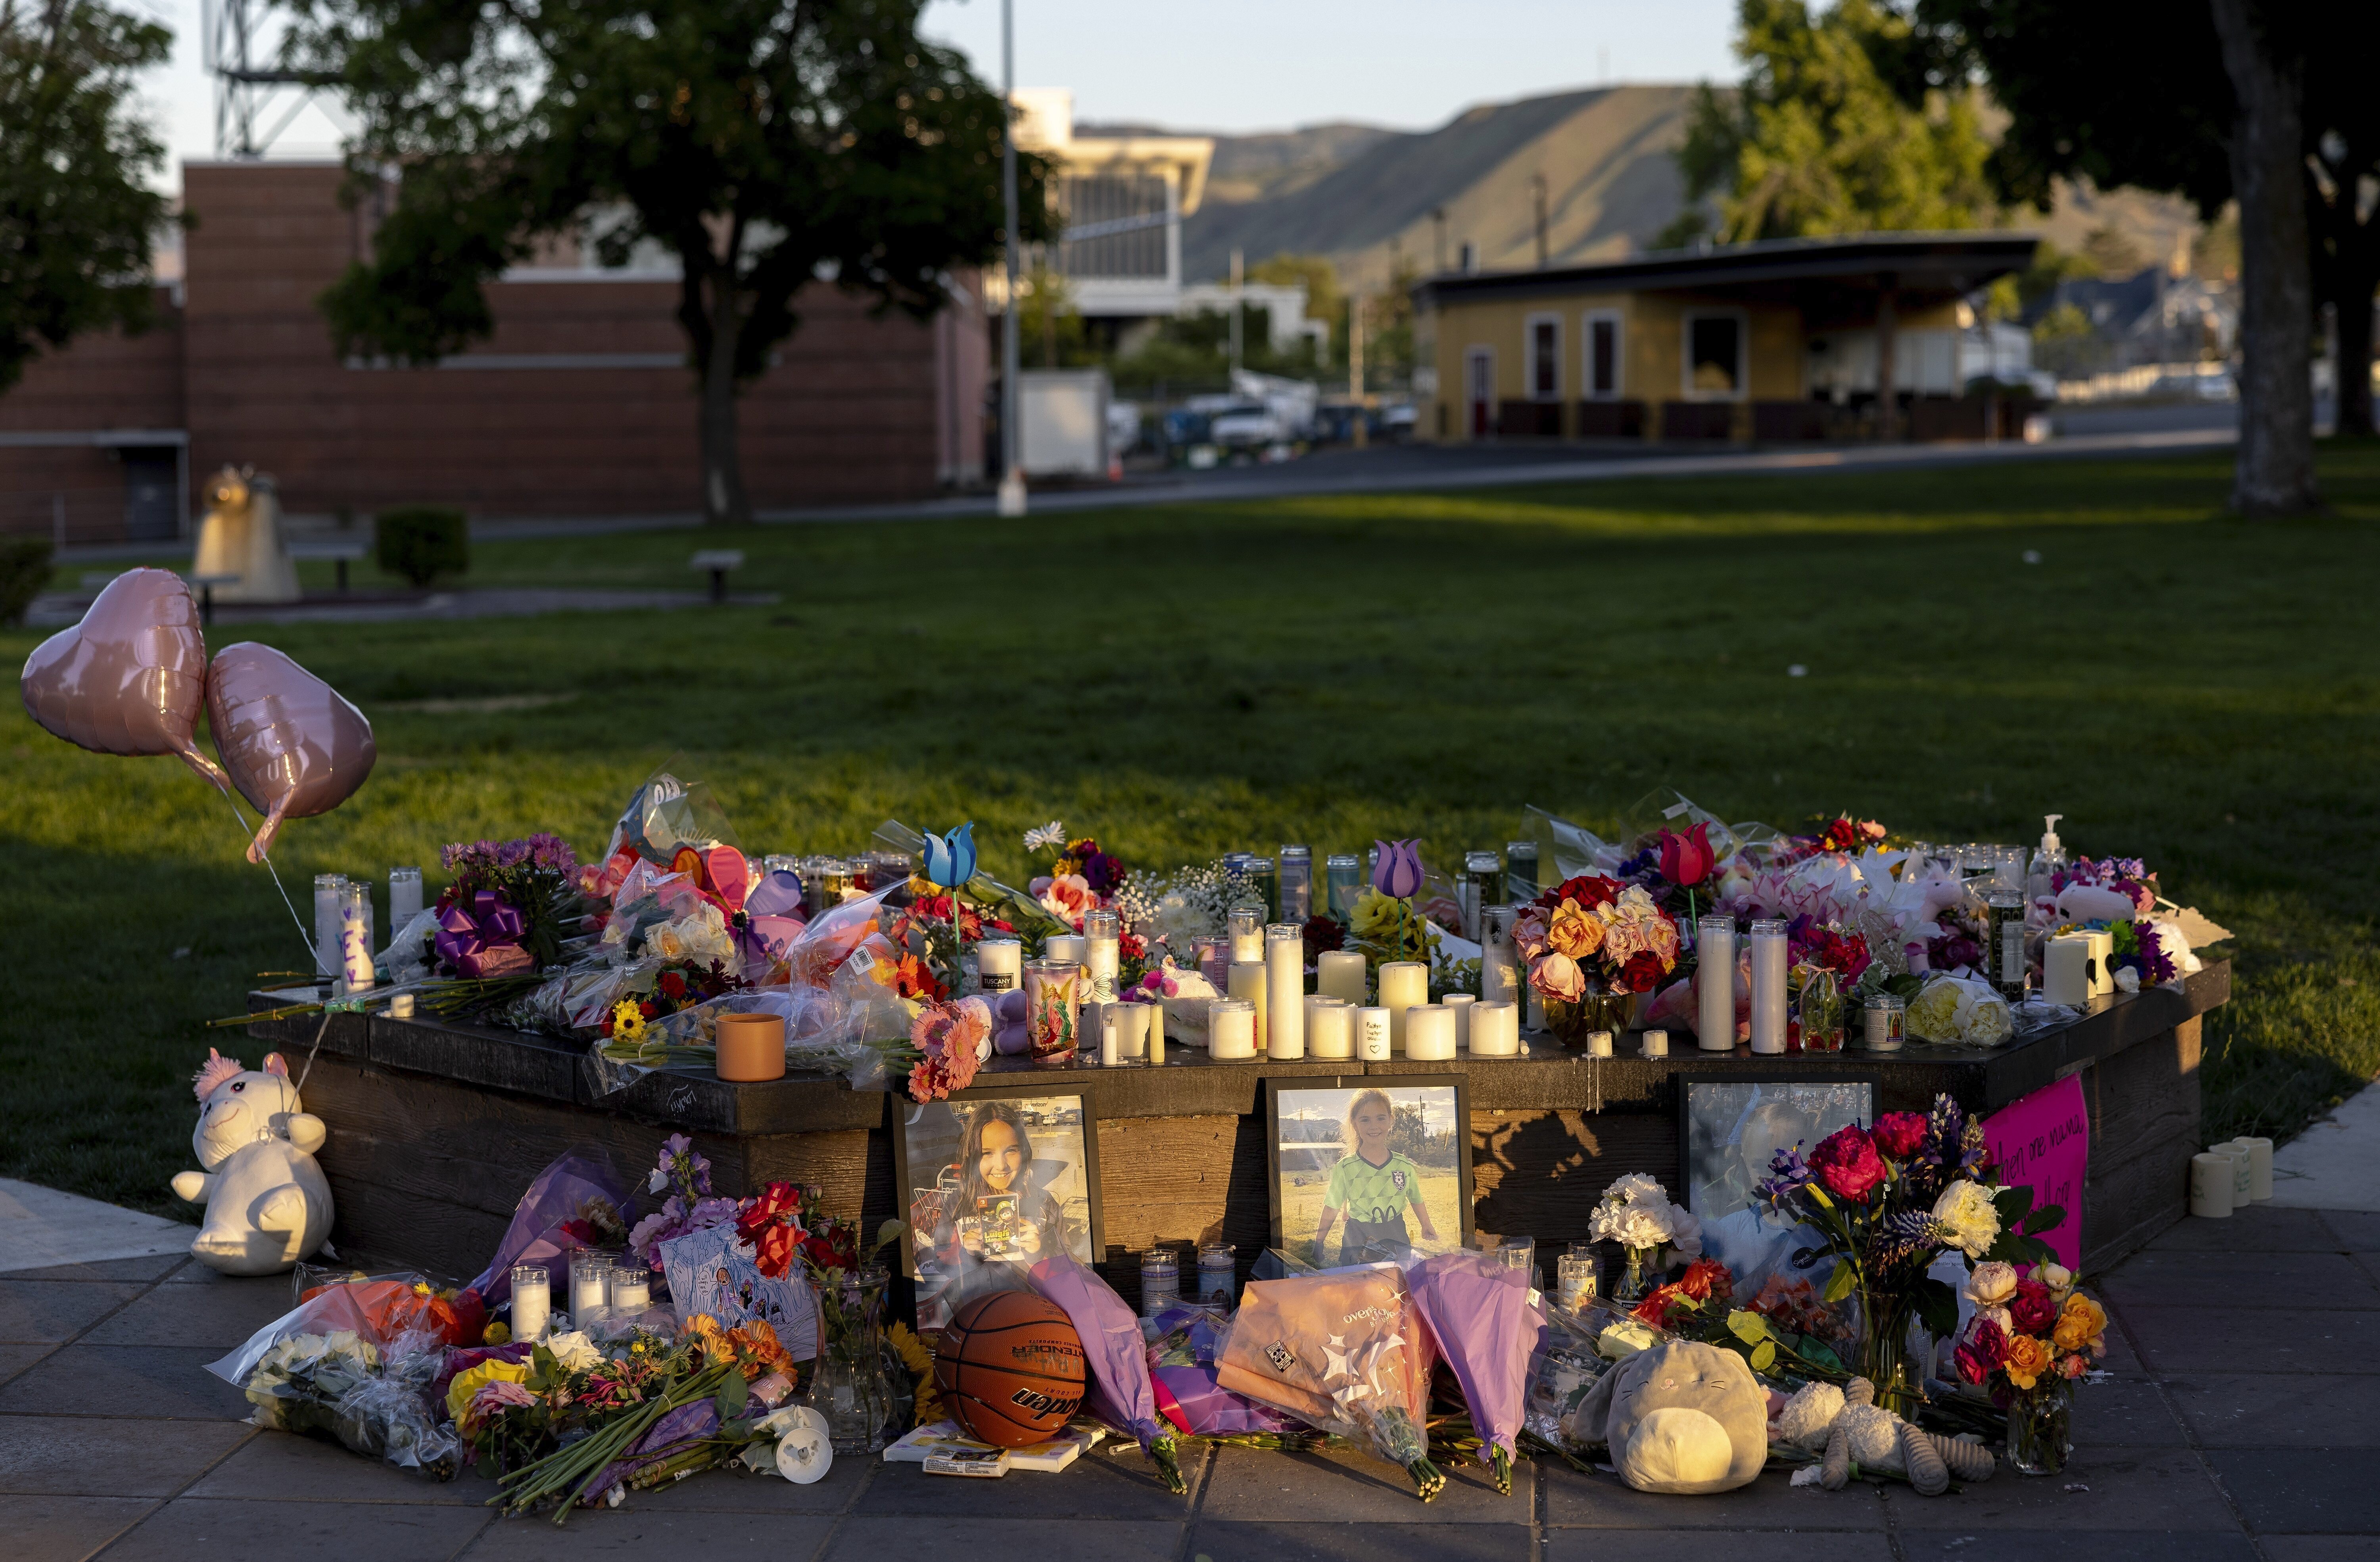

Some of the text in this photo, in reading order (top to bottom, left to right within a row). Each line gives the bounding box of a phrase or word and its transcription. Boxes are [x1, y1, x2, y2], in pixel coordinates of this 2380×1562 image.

[1998, 1140, 2025, 1185] hen
[2029, 1136, 2046, 1161] one
[984, 1230, 1010, 1238] Luigi's
[733, 1240, 755, 1253] frie
[1793, 1254, 1811, 1266] Signatu
[1012, 1345, 1083, 1358] NTENDER
[1279, 1357, 1290, 1368] PLASTIC
[1282, 1361, 1291, 1370] WRAP
[758, 1380, 775, 1391] OOM
[1044, 1387, 1070, 1395] COURT
